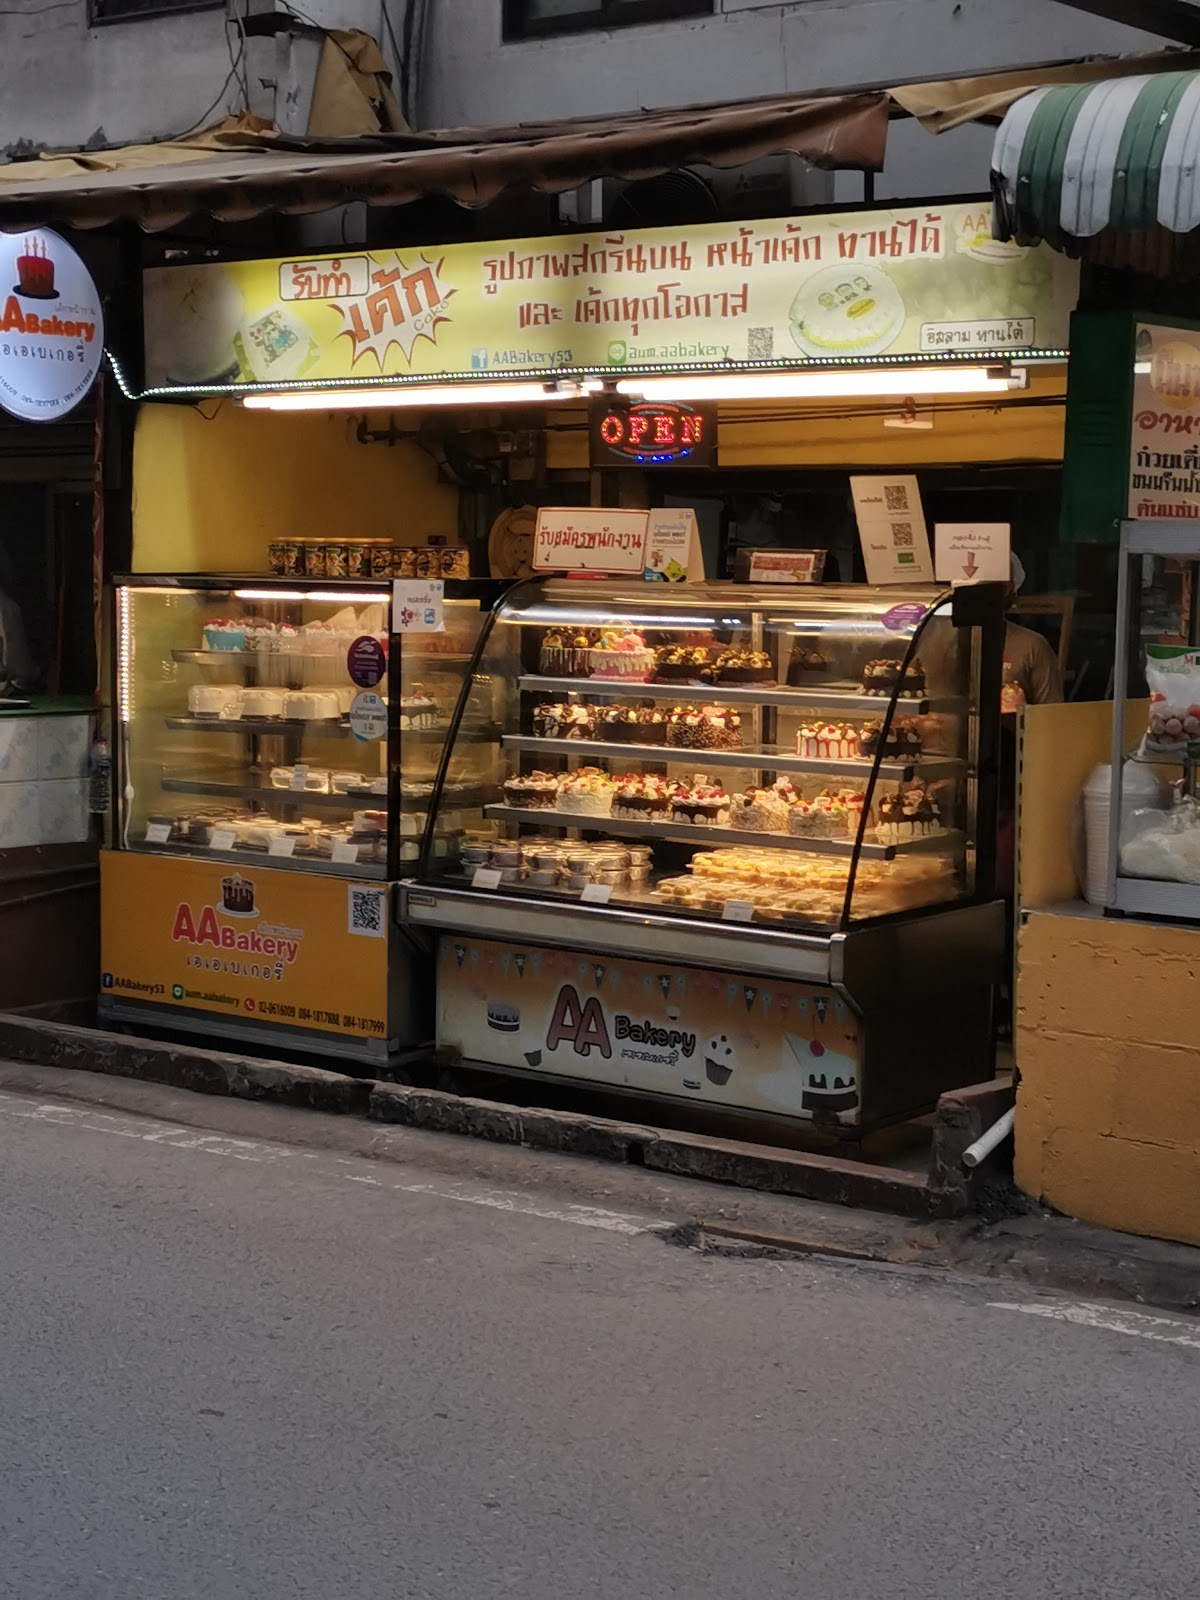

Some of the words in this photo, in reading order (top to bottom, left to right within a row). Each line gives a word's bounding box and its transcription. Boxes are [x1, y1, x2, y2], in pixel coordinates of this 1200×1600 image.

[962, 214, 988, 232] AA
[484, 235, 692, 294] รูปภาพสกรีนบน
[706, 223, 822, 268] หน้าเค้ก
[837, 213, 942, 259] ทานได้
[291, 259, 351, 299] รับทำ
[0, 295, 95, 343] ABakery
[348, 267, 441, 344] เค้ก
[518, 302, 564, 329] และ
[574, 283, 750, 337] เค้กทุกโอกาส
[629, 342, 731, 360] aum.aabakery
[976, 321, 1024, 343] ทานได้
[493, 350, 573, 367] AABakery53
[601, 416, 704, 445] OPEN
[546, 984, 612, 1060] AA
[614, 1015, 697, 1058] Bakery
